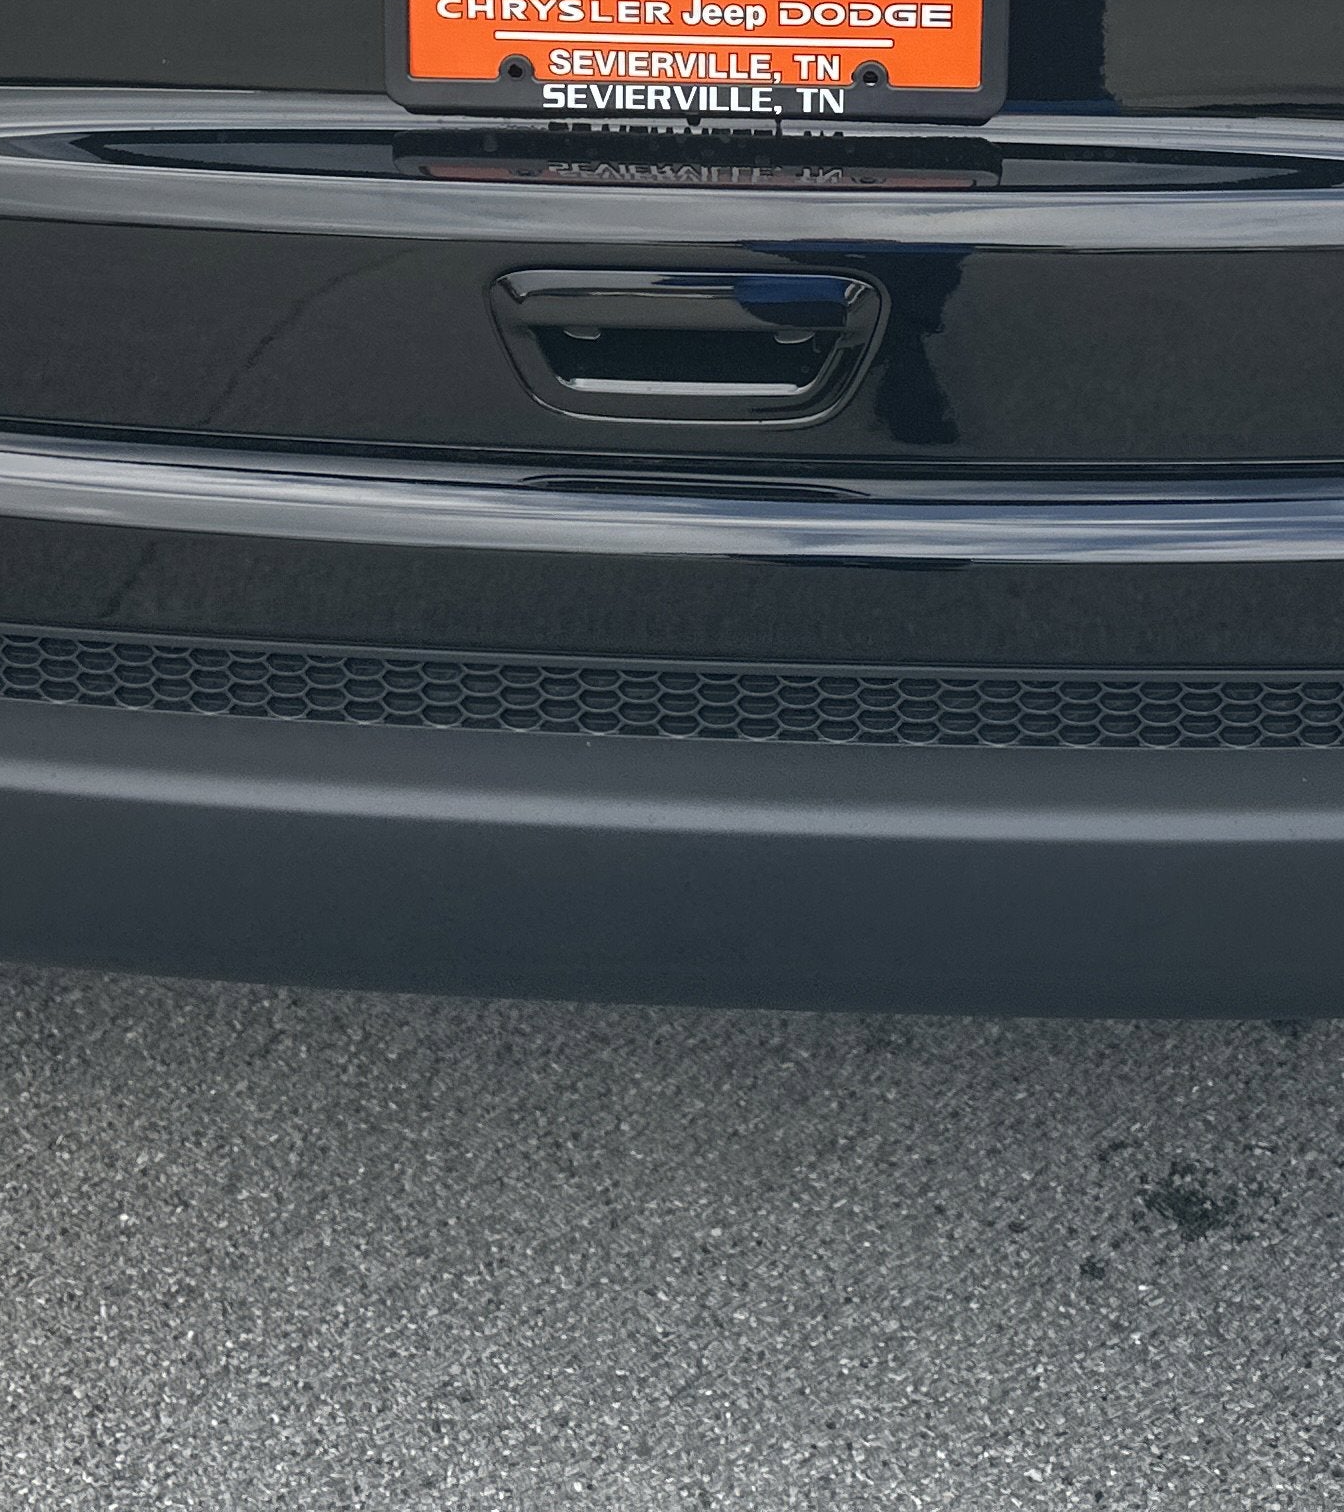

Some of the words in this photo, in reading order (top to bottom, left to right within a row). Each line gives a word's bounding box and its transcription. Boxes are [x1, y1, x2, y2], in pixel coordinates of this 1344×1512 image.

[778, 2, 953, 29] DODGE
[548, 49, 782, 84] SEVIERVILLE,
[793, 53, 841, 82] TN
[542, 84, 782, 115] SEVIERVILLE,
[797, 88, 845, 114] TN
